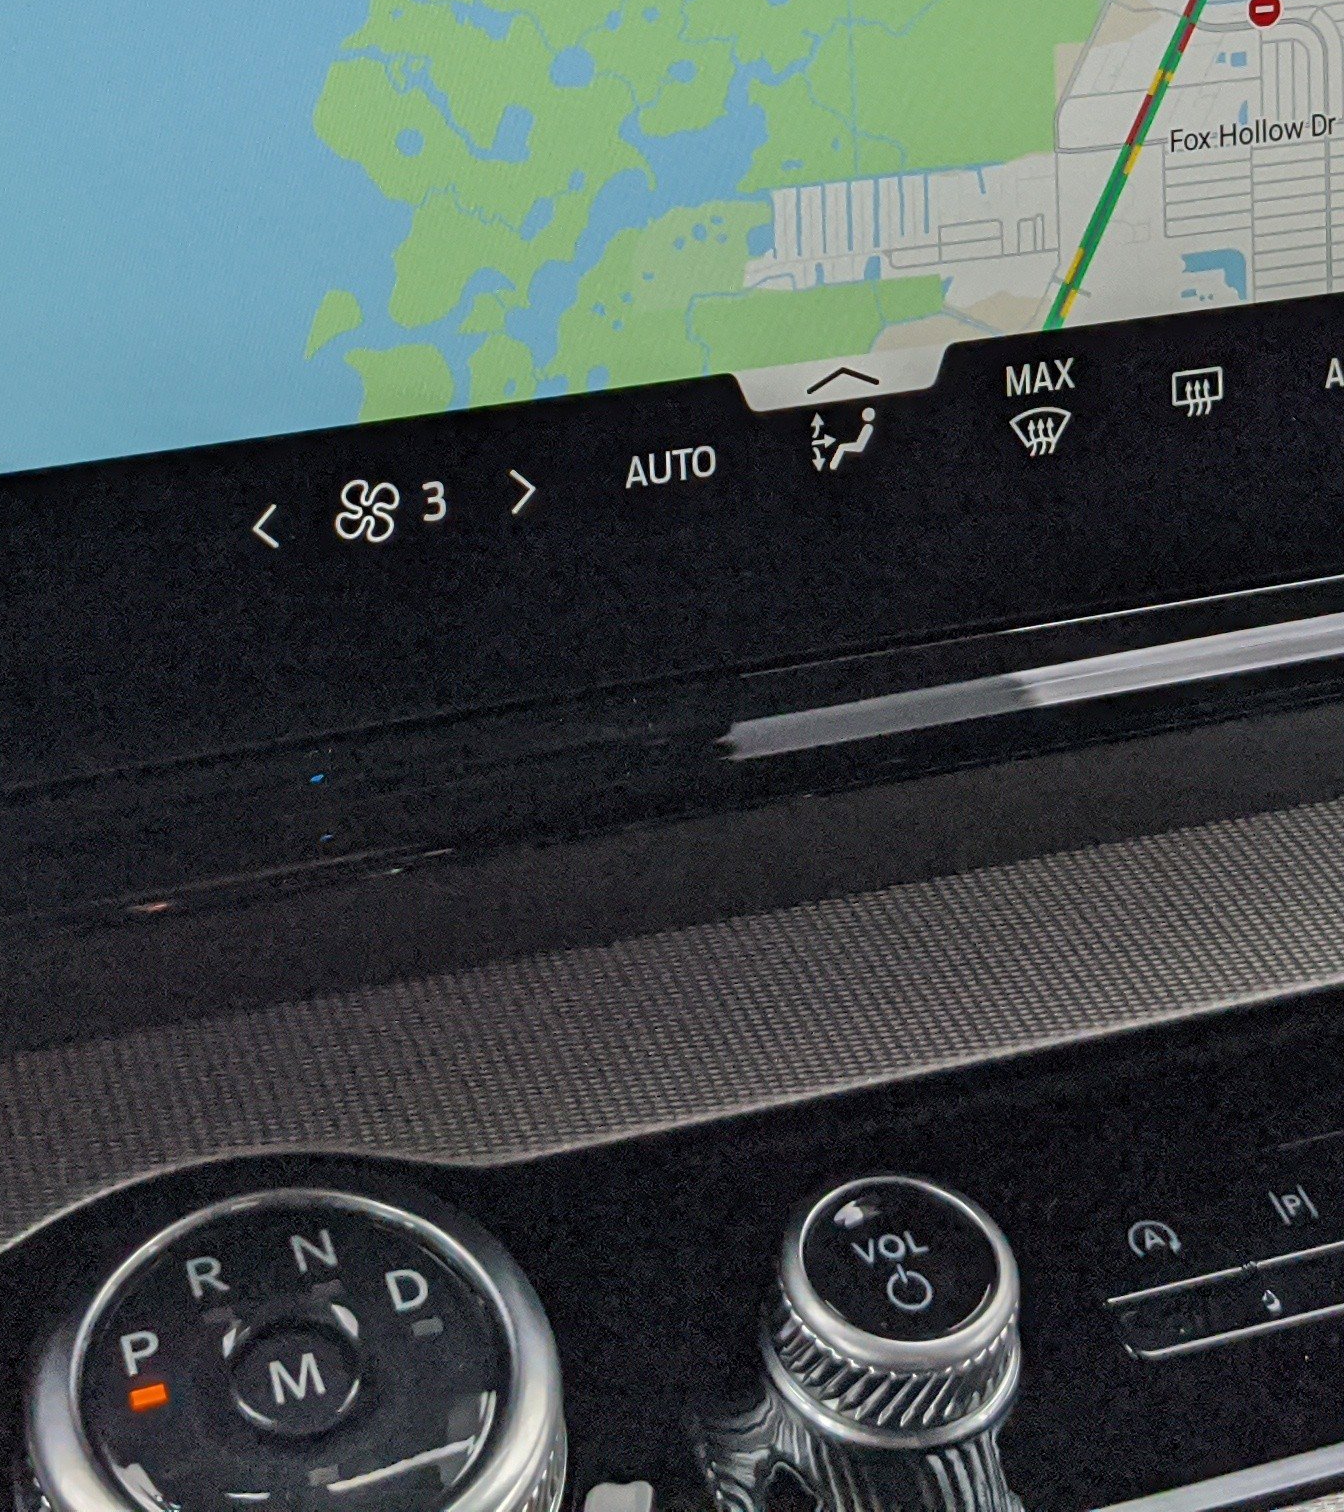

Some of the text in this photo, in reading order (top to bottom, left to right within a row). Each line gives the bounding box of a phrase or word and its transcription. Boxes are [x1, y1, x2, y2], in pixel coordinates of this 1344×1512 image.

[1170, 112, 1337, 153] Fox Hollow Dr
[1005, 357, 1076, 397] MAX
[624, 444, 718, 489] AUTO
[422, 480, 447, 522] 3
[289, 1228, 339, 1273] N
[850, 1230, 930, 1266] VOL
[185, 1255, 230, 1298] R
[385, 1268, 429, 1313] D
[120, 1329, 160, 1377] P
[268, 1352, 327, 1404] M
